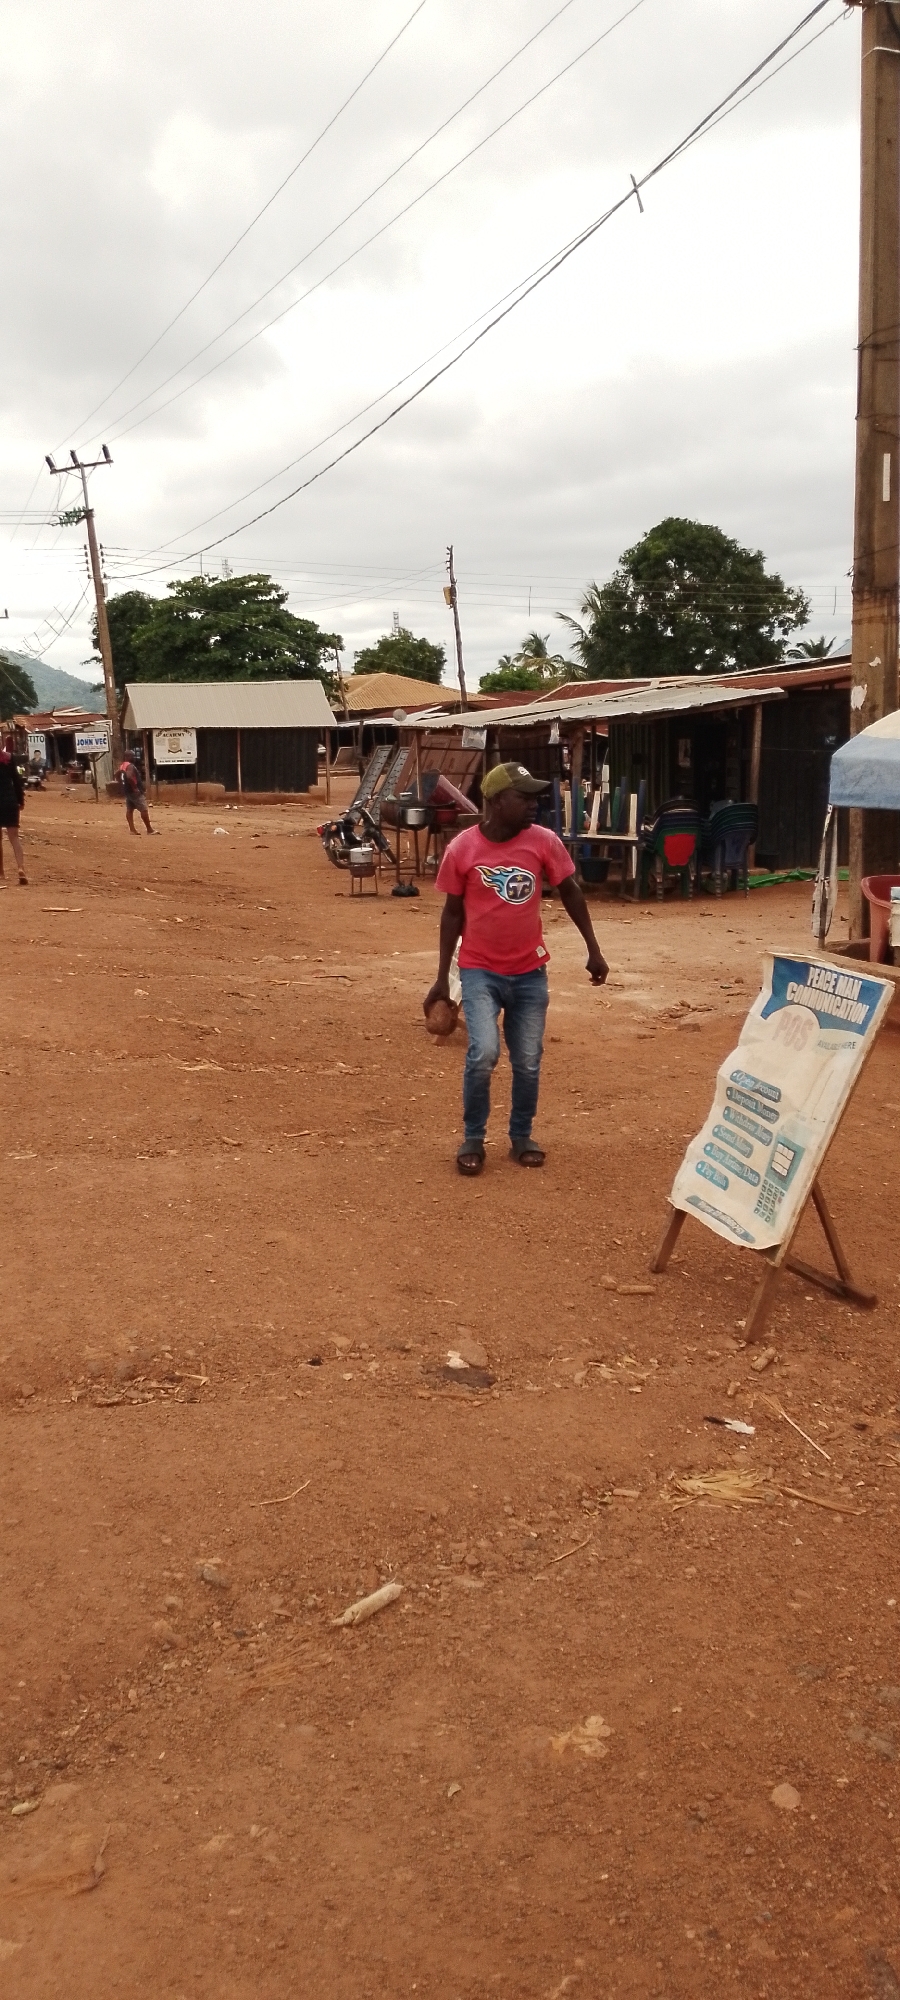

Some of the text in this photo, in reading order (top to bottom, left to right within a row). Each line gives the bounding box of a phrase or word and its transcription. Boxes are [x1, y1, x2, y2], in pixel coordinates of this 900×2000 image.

[28, 735, 45, 743] TITO
[806, 966, 863, 1001] PEACE MAN
[786, 981, 870, 1025] COMMUNICATION
[772, 1010, 814, 1052] POS
[736, 1071, 755, 1087] Open
[732, 1090, 779, 1122] Deposit Money
[718, 1126, 737, 1143] Send
[711, 1145, 725, 1162] Buy
[701, 1163, 714, 1178] Pay
